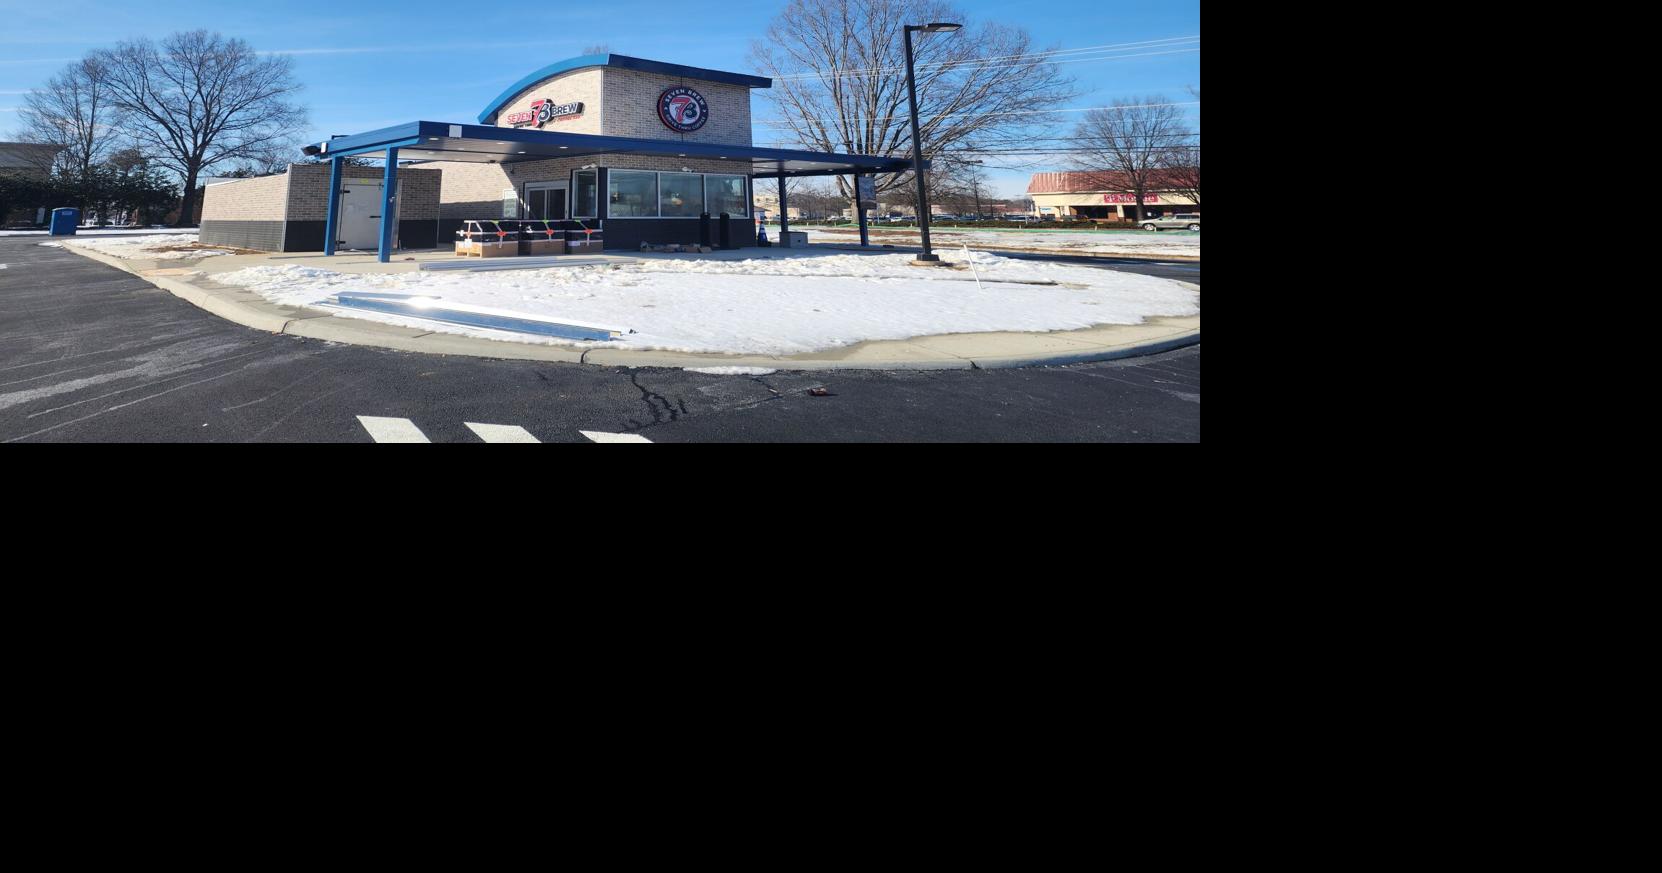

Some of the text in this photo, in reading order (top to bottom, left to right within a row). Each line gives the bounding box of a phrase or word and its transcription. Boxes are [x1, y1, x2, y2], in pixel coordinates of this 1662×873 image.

[665, 89, 705, 105] SEVEN BREW
[507, 112, 532, 124] SEVEN
[551, 103, 578, 117] BREW
